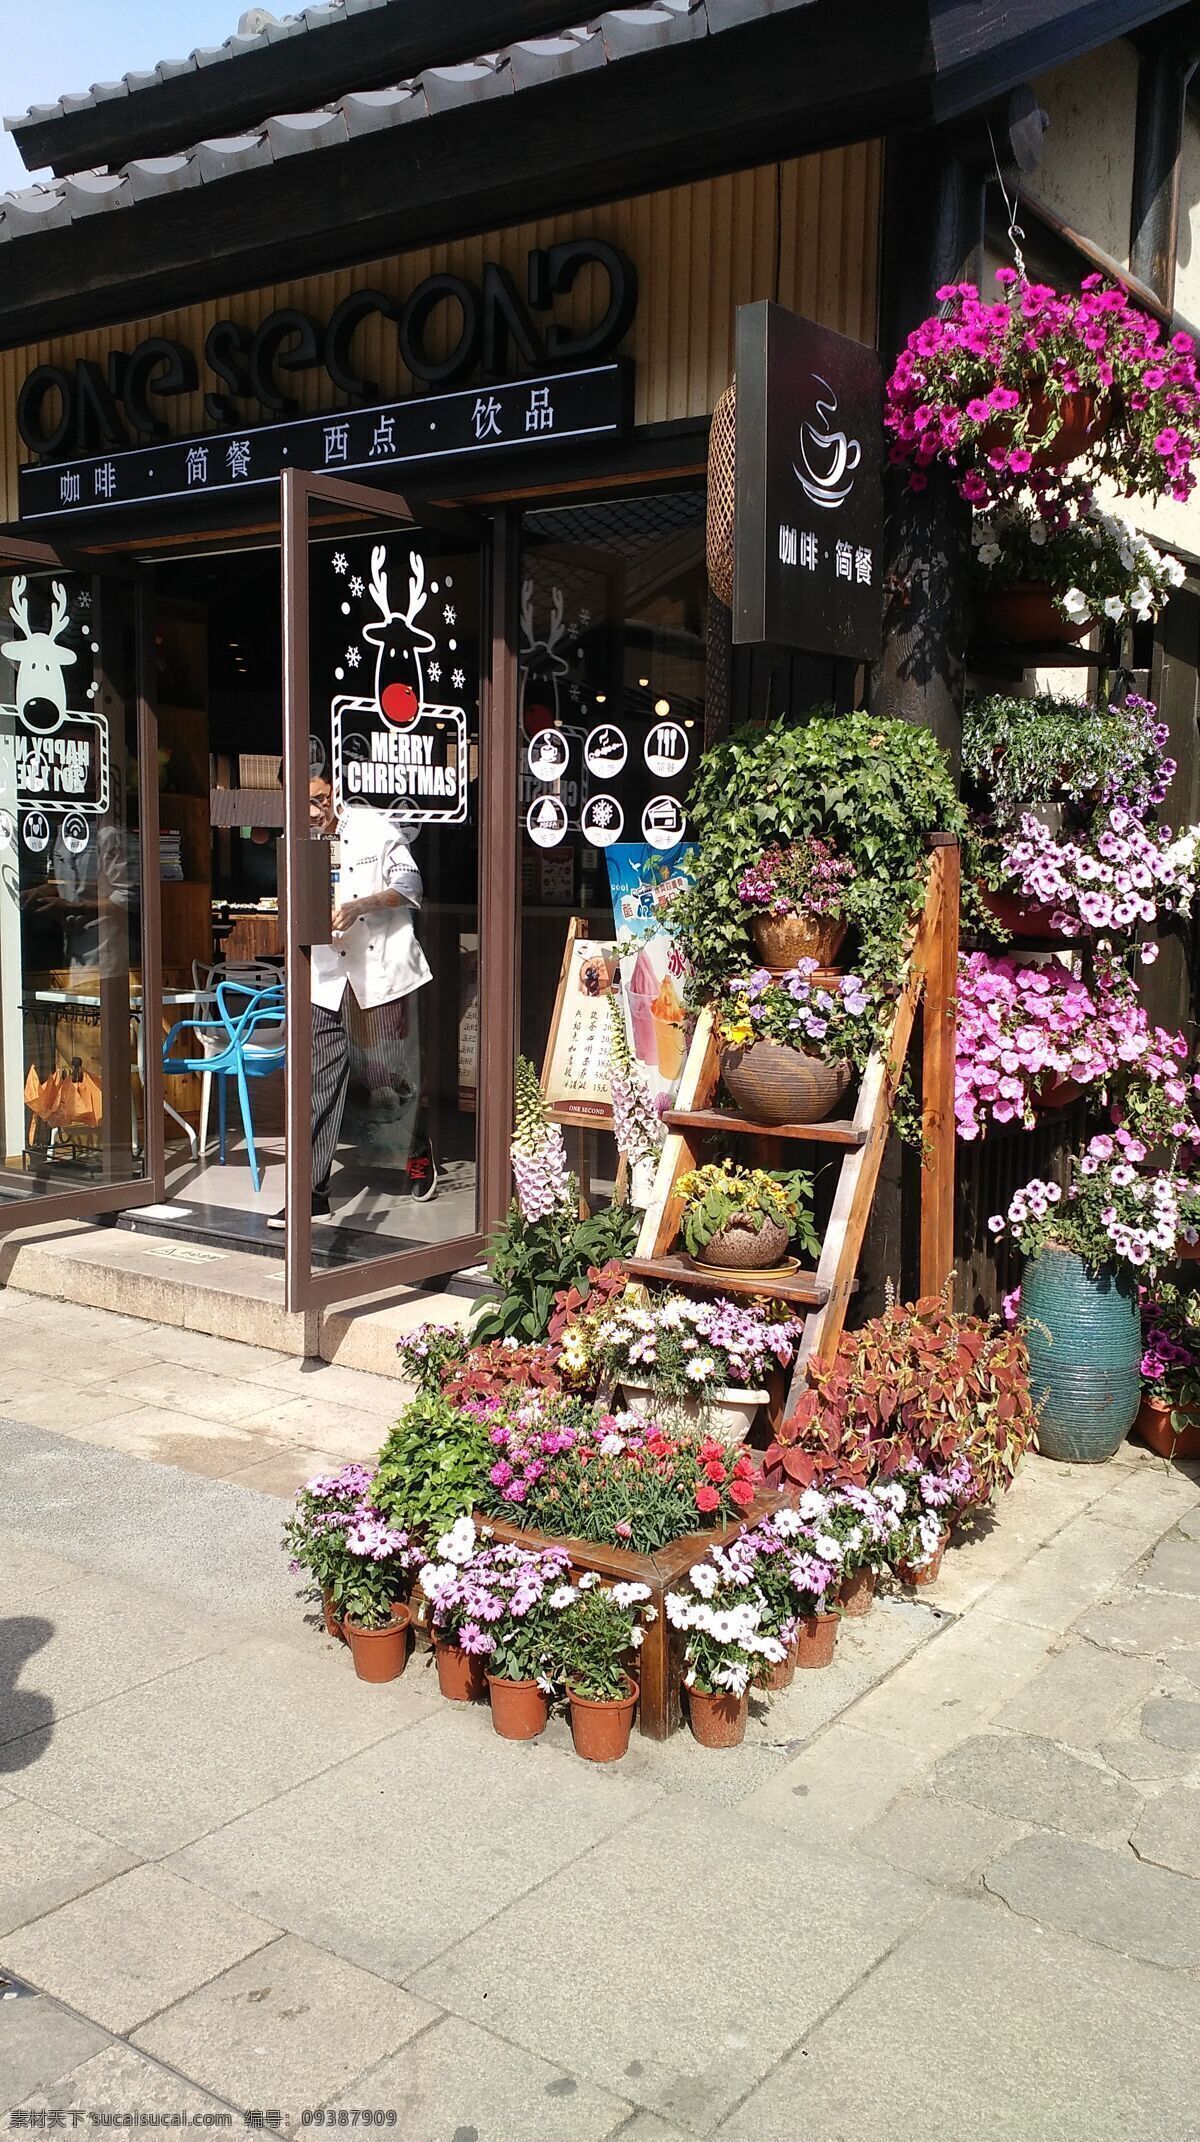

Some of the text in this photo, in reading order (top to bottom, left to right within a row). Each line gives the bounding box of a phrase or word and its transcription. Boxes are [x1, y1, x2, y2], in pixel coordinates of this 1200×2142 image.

[60, 387, 554, 506] 咖啡 简餐 西点 饮品
[371, 732, 434, 766] MERRY
[347, 761, 457, 797] CHRISTMAS
[568, 1105, 605, 1115] ONE SECOND
